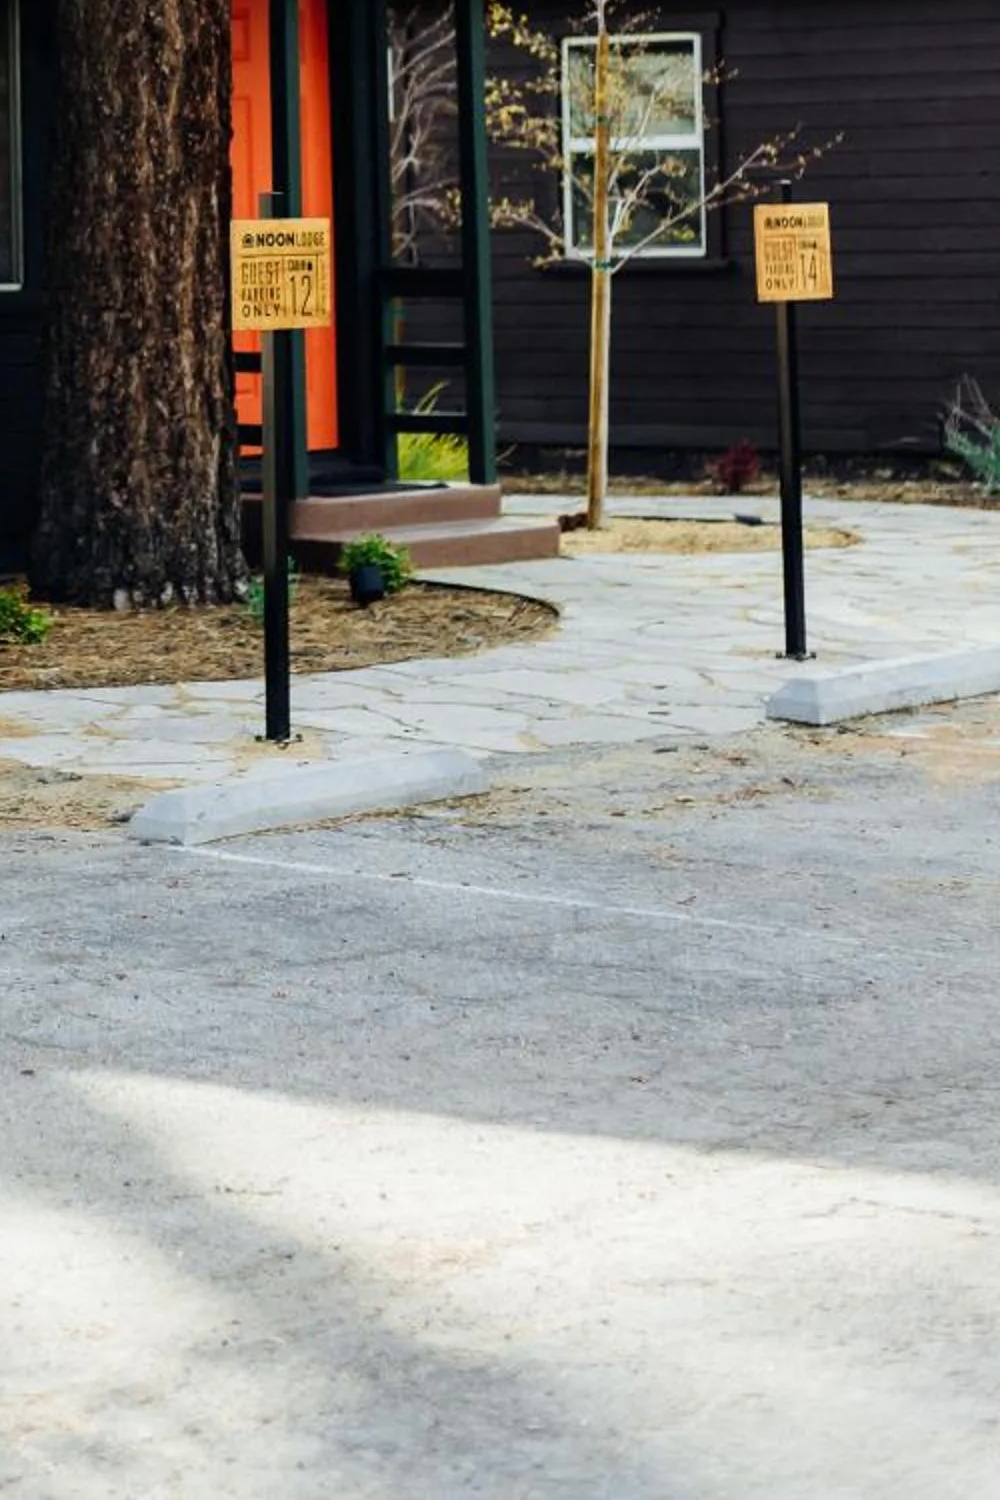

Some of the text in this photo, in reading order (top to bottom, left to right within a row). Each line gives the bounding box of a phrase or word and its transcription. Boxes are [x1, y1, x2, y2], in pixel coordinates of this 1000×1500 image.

[241, 261, 280, 285] GUEST
[801, 254, 817, 290] 14
[290, 275, 312, 317] 12
[765, 278, 795, 291] ONLY
[241, 303, 281, 318] ONLY
